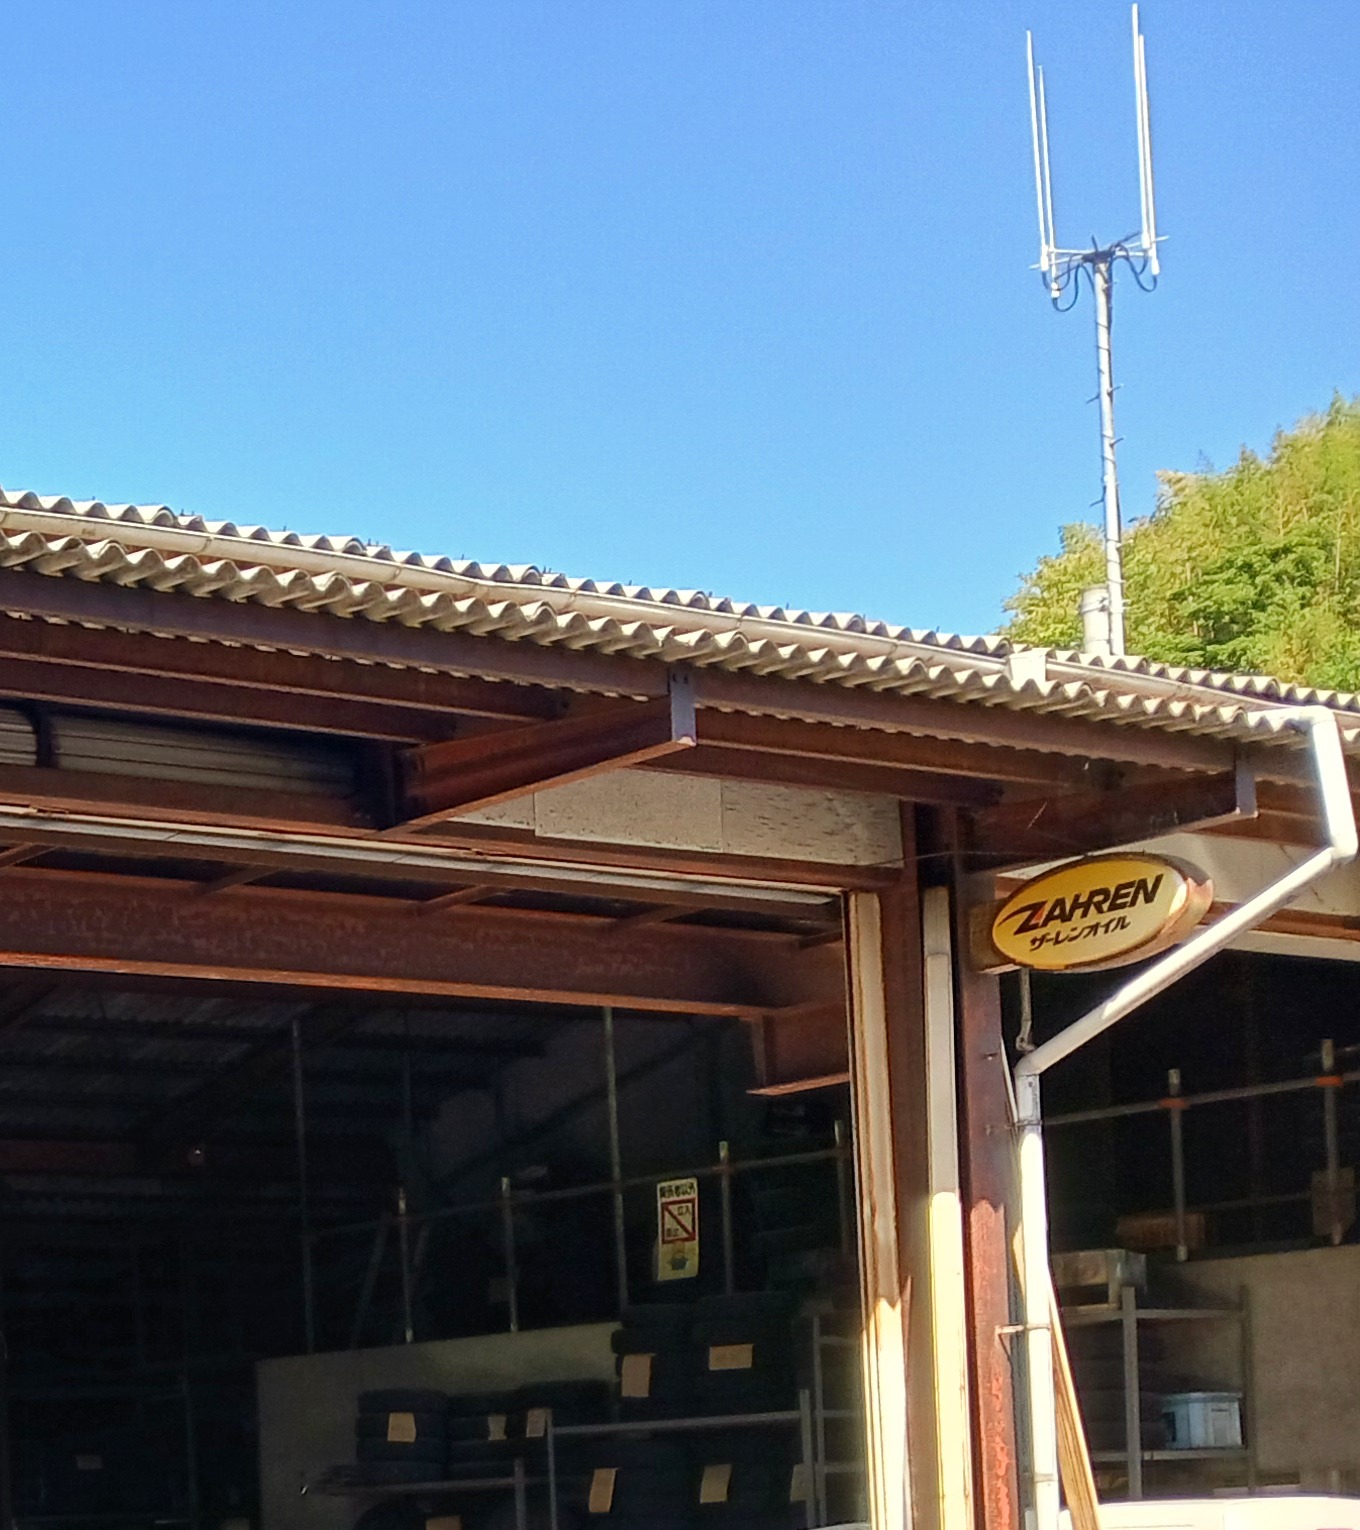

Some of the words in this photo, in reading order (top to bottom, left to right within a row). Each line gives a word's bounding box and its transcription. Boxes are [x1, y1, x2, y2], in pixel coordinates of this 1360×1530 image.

[997, 873, 1164, 936] ZAHREN
[1029, 914, 1131, 952] ザーレンオイル
